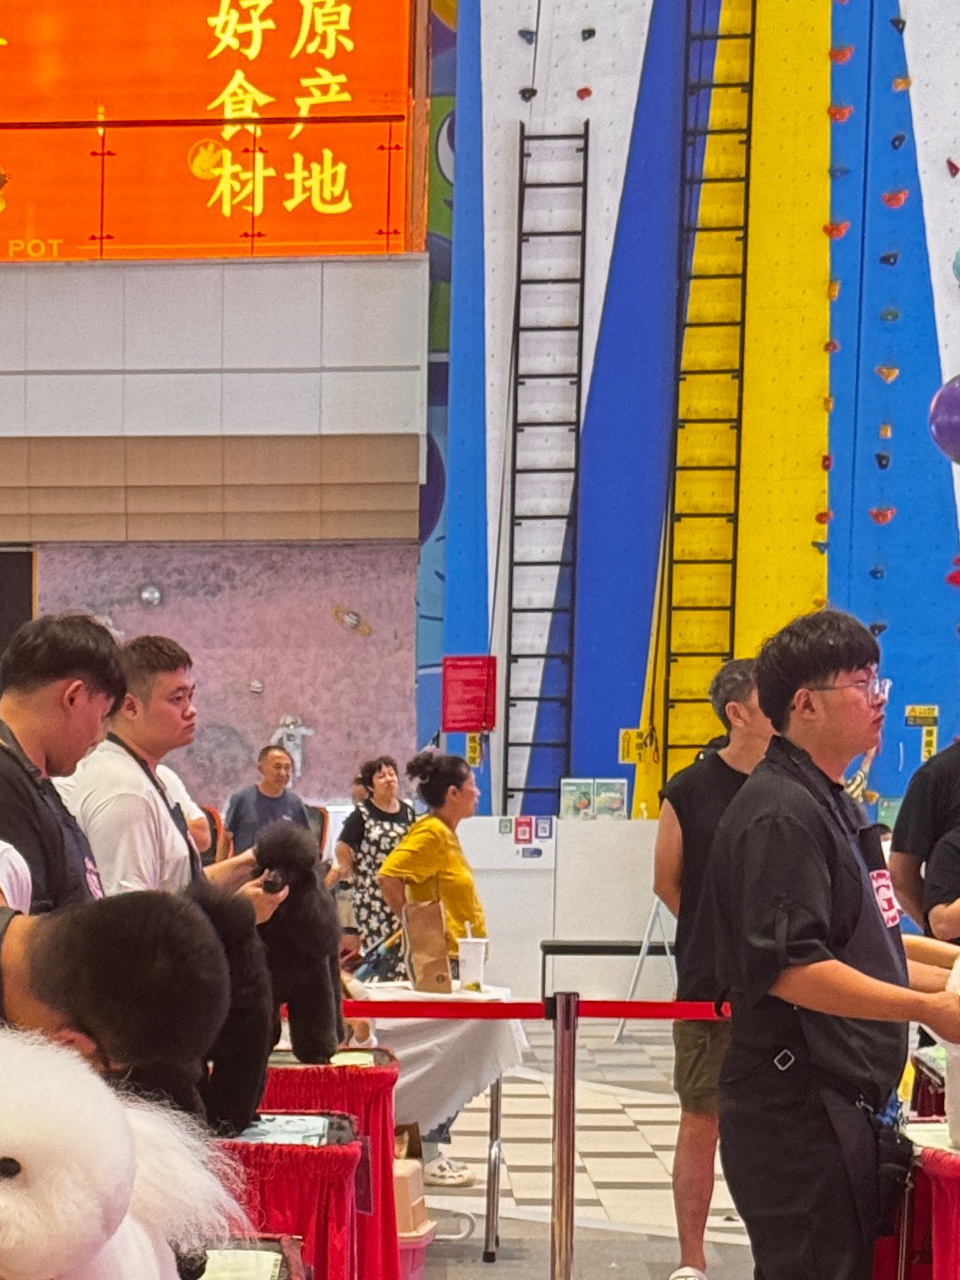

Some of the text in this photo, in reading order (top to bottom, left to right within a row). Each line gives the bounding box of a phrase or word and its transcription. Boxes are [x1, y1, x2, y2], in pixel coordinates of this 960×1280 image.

[206, 0, 278, 218] 好食材
[282, 0, 355, 215] 原产地
[8, 238, 65, 258] POT
